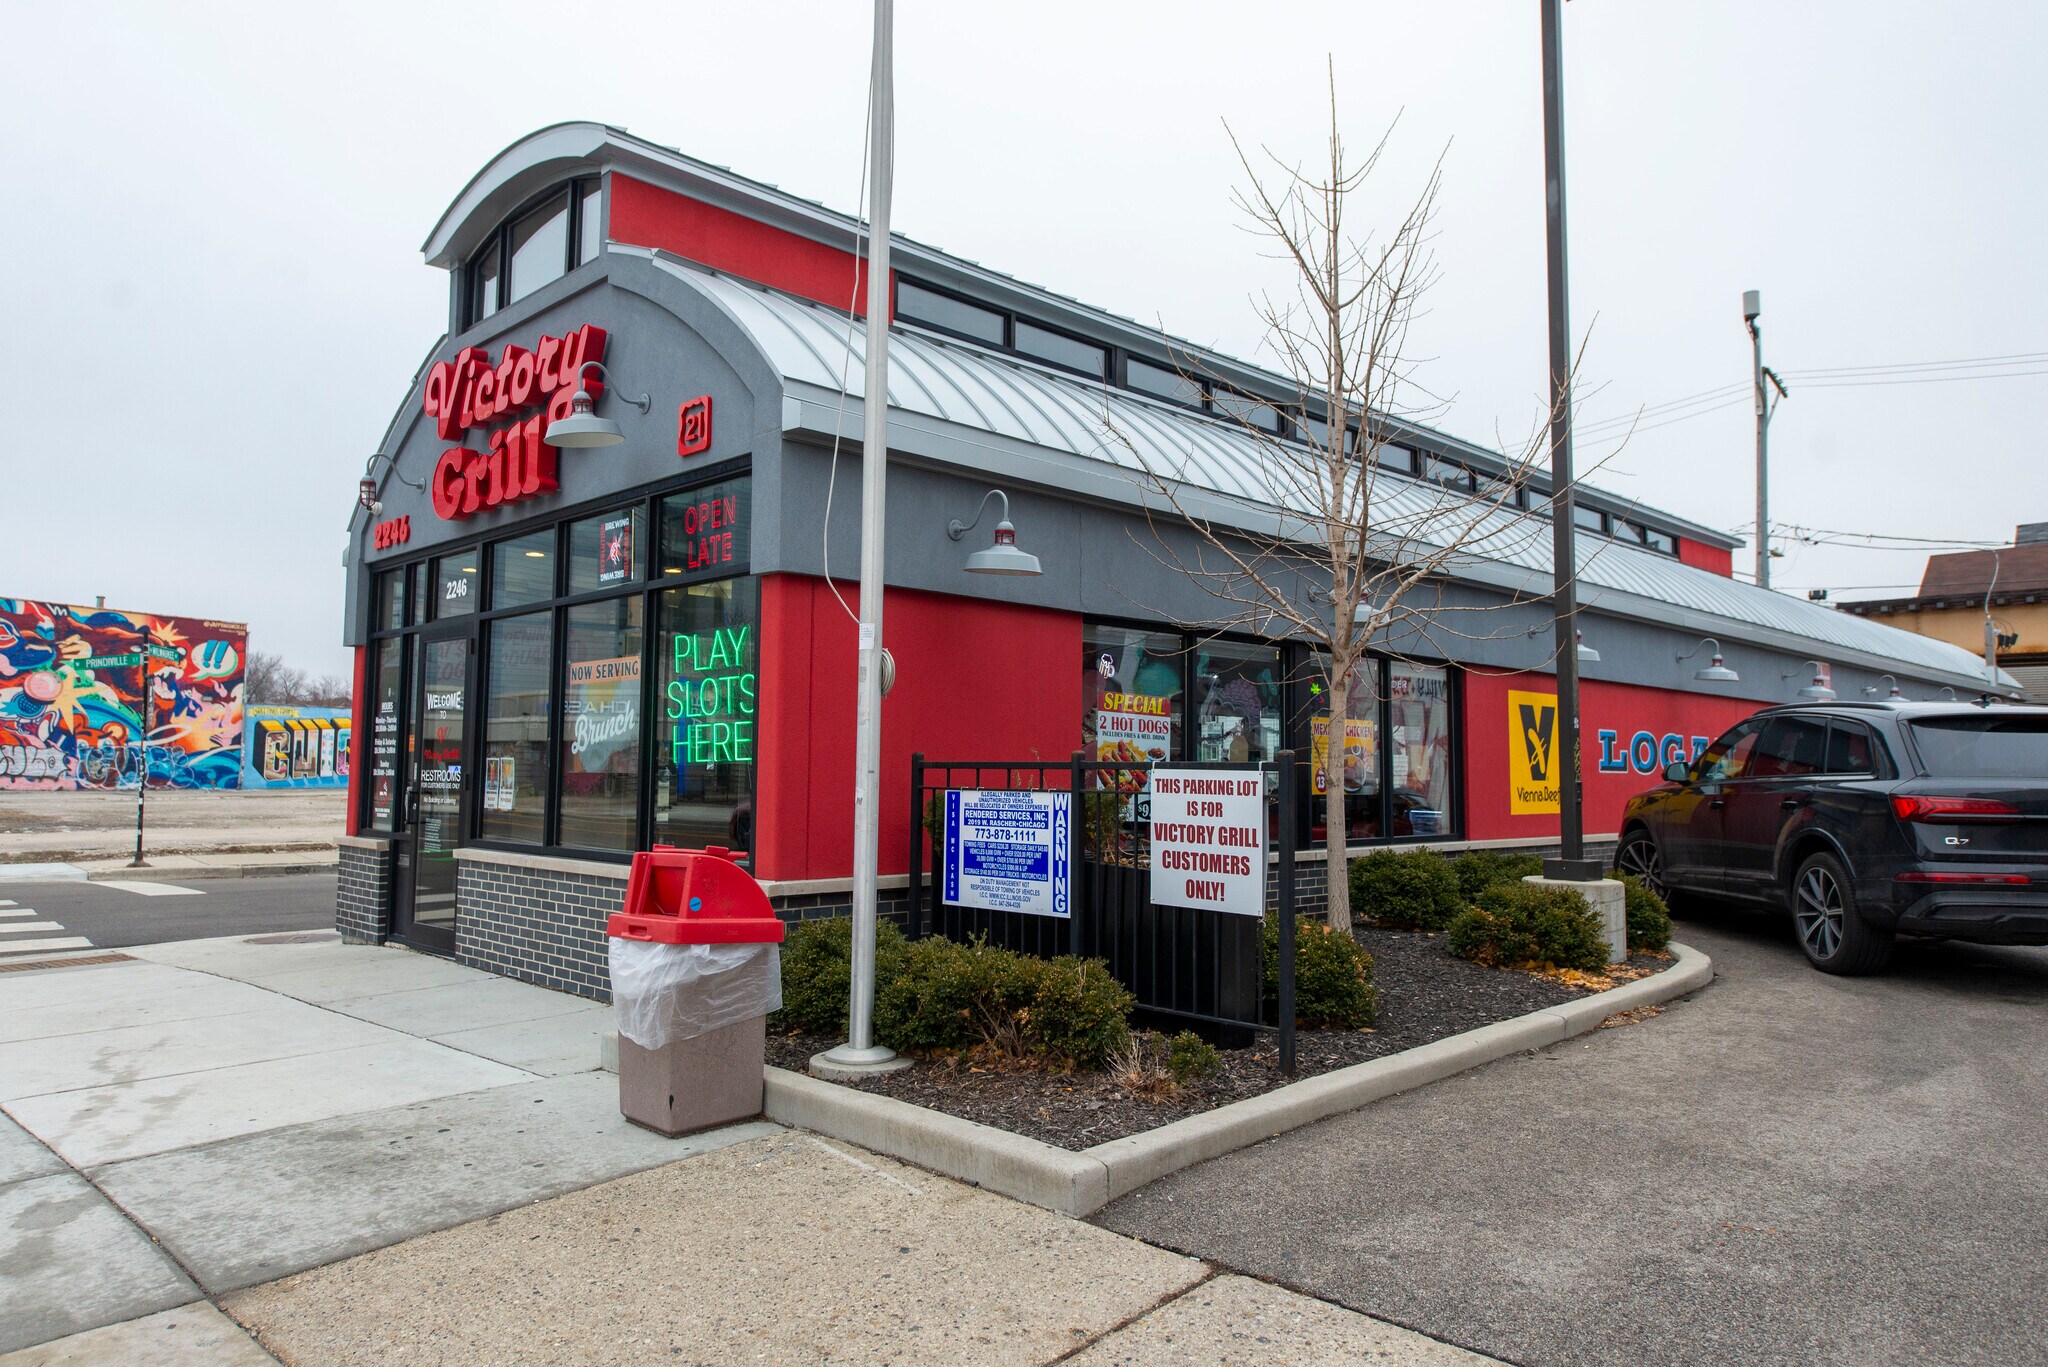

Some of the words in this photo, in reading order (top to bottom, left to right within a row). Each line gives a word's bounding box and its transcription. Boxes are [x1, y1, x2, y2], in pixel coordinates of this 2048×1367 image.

[424, 323, 607, 441] Victory
[685, 411, 705, 442] 21
[432, 414, 559, 522] Grill
[605, 517, 630, 531] BREWING
[684, 495, 736, 535] OPEN
[373, 514, 410, 550] 2246
[688, 532, 733, 569] LATE
[446, 578, 467, 599] 2246
[152, 647, 175, 660] MILWAUKEE
[674, 626, 748, 673] PLAY
[86, 655, 128, 668] PRINDIVILLE
[571, 665, 593, 681] NOW
[596, 660, 639, 679] SERVING
[427, 690, 461, 711] WELCOME
[667, 673, 754, 719] SLOTS
[1103, 692, 1166, 715] SPECIAL
[440, 710, 446, 719] TO
[1099, 715, 1107, 730] 2
[1111, 716, 1135, 732] HOT
[1138, 719, 1169, 735] DOGS
[571, 700, 636, 755] Brunch
[1346, 725, 1373, 738] CHICKEN
[673, 721, 753, 764] HERE
[421, 769, 461, 782] RESTROOMS
[1155, 778, 1180, 794] THIS
[1183, 779, 1234, 796] PARKING
[1237, 780, 1259, 797] LOT
[1517, 787, 1543, 803] Vienna
[965, 809, 998, 819] RENDERED
[999, 811, 1033, 821] SERVICES,
[1034, 812, 1048, 821] INC.
[1186, 800, 1198, 816] IS
[1201, 801, 1223, 818] FOR
[975, 828, 1036, 841] 773-878-1111
[1154, 823, 1216, 845] VICTORY
[1218, 826, 1259, 848] GRILL
[1945, 837, 1969, 845] Q7
[1053, 793, 1068, 912] WARNING
[1162, 850, 1250, 876] CUSTOMERS
[970, 883, 995, 892] RESPONSIBLE
[1001, 886, 1016, 894] TOWING
[1021, 888, 1040, 897] VEHICLES
[1186, 879, 1225, 902] ONLY!
